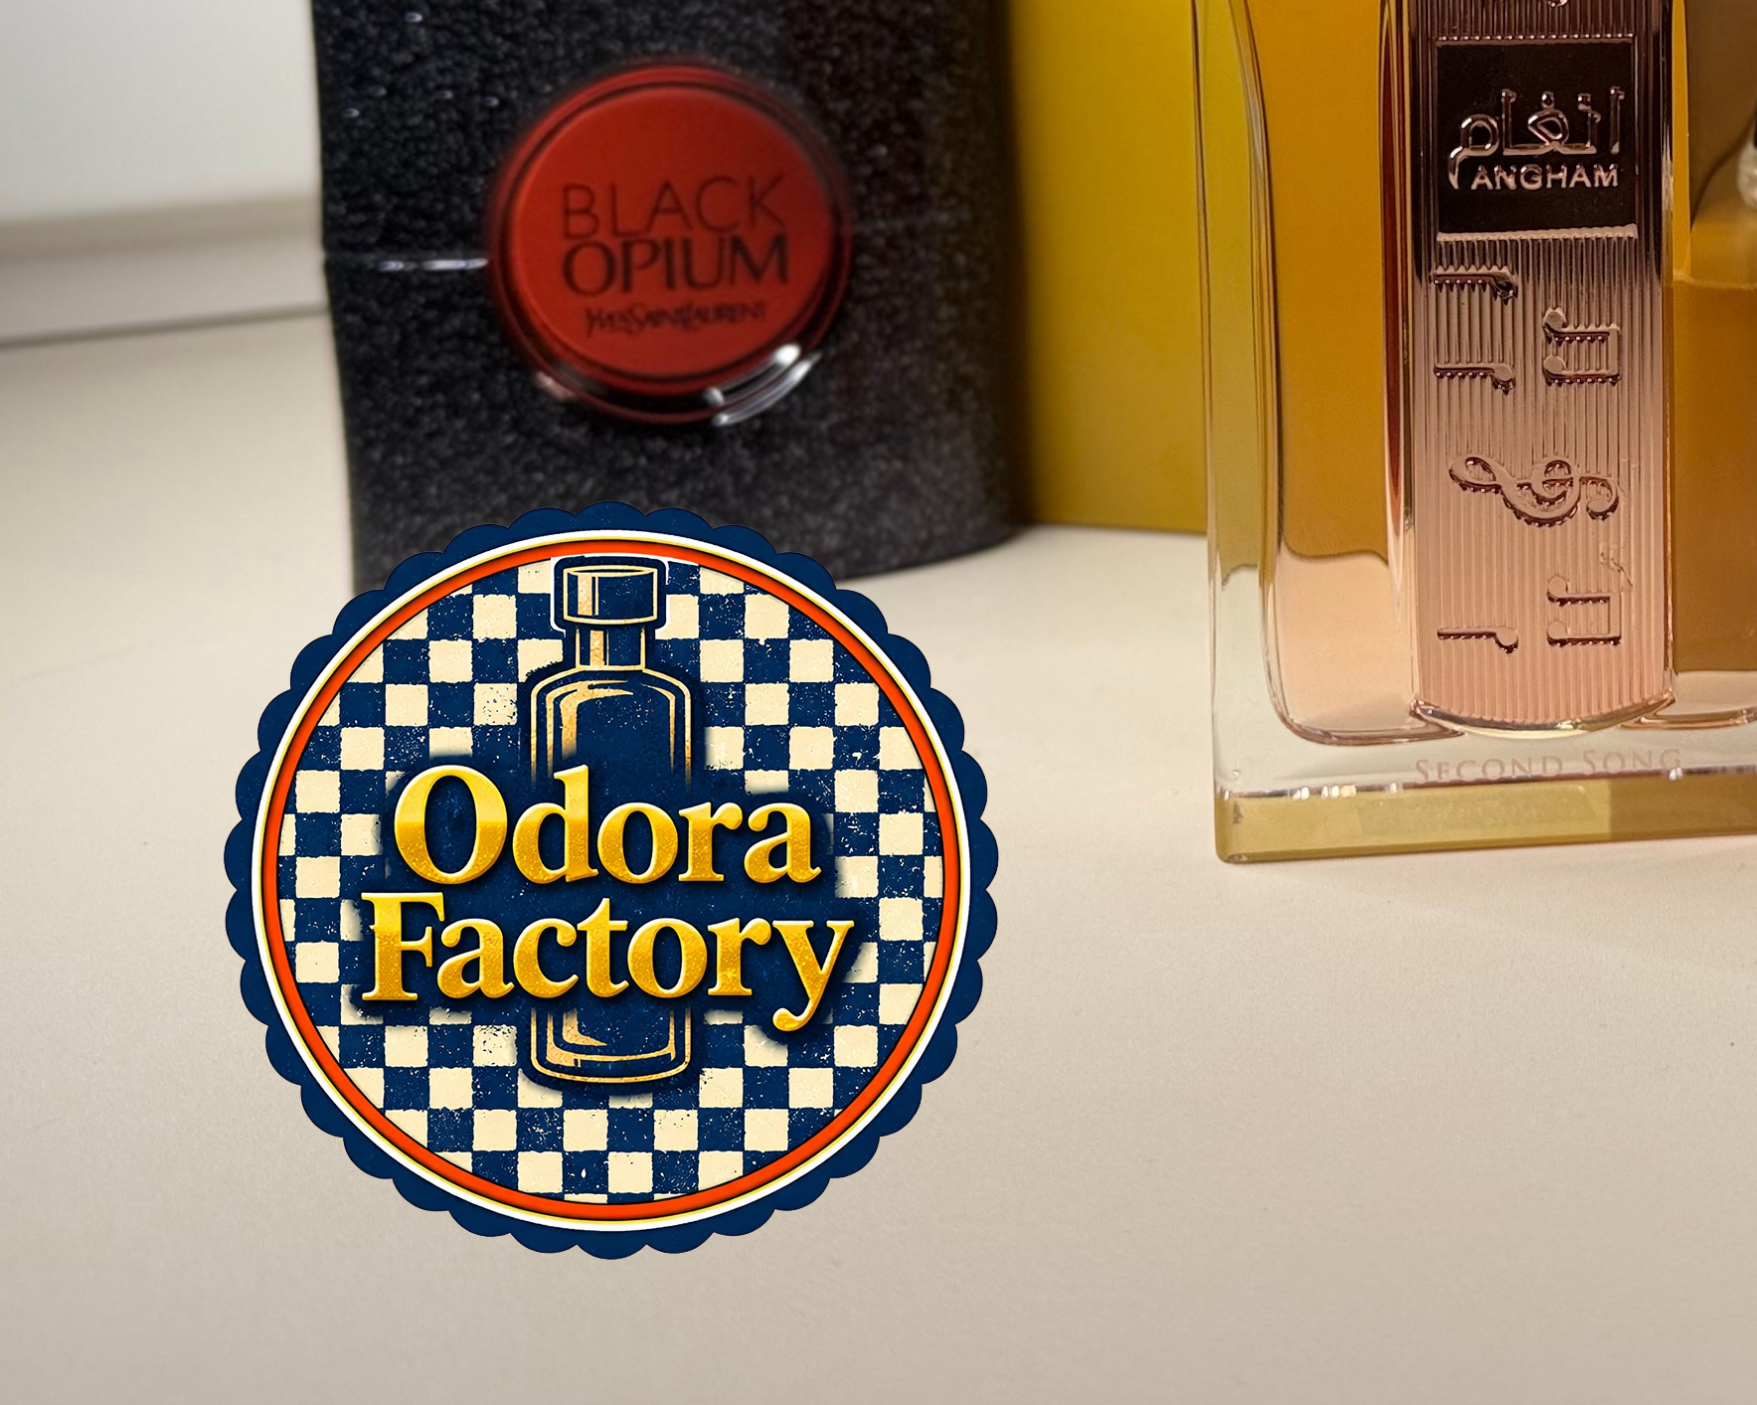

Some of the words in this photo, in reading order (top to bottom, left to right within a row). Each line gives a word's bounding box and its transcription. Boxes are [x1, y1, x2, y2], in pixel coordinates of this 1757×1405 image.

[561, 173, 788, 240] BLACK
[1470, 164, 1620, 191] ANGHAM
[561, 231, 791, 297] OPIUM
